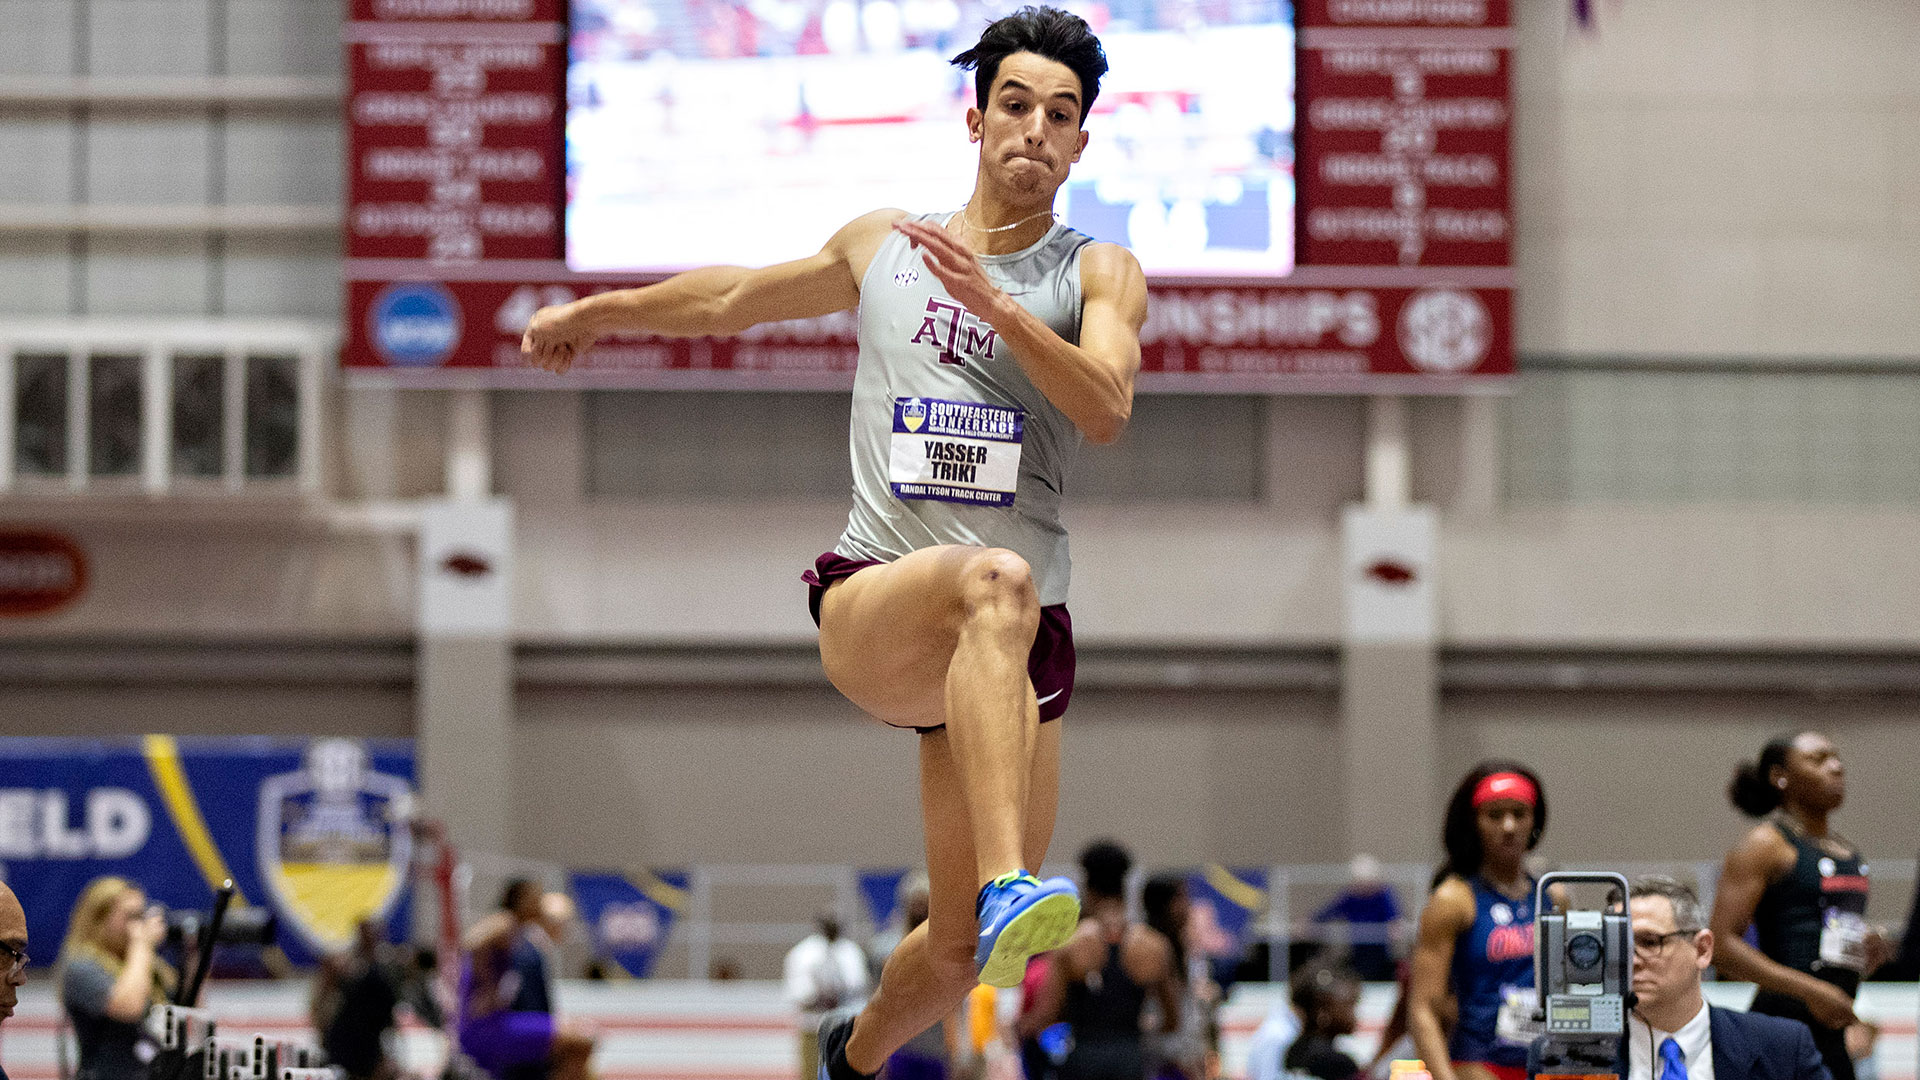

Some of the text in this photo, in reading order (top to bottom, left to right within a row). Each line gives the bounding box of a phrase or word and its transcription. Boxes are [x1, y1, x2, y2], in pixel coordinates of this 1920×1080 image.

[1142, 287, 1381, 346] ONSHIPS
[930, 402, 1015, 423] SOUTHEASTERN
[929, 414, 1015, 434] CONFERENCE
[924, 440, 988, 464] YASSER
[931, 461, 977, 483] TRIKI
[900, 483, 1002, 502] RANDAL TYSON TRACK CENTER
